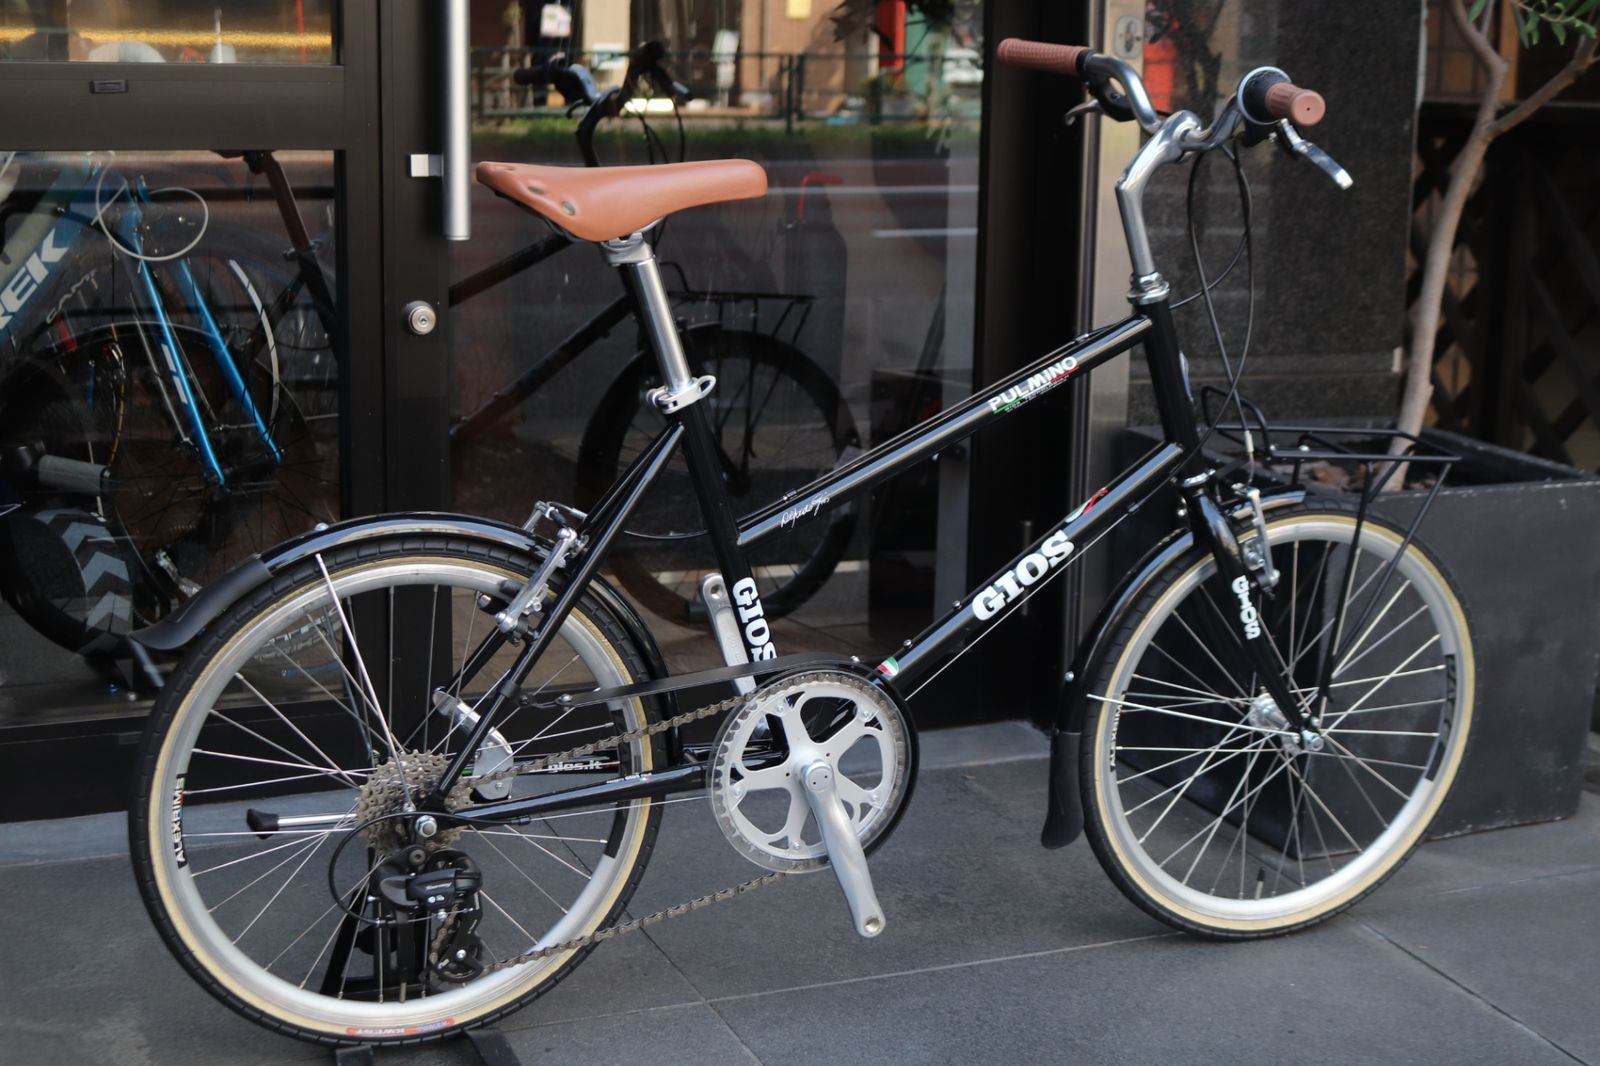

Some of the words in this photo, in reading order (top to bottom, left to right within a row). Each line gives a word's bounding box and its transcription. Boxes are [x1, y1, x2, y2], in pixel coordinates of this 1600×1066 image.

[988, 356, 1078, 411] PULMINO
[972, 529, 1075, 620] GIOS
[1231, 574, 1261, 640] GIOS
[732, 576, 778, 663] GIOS
[172, 777, 186, 862] ALEXRIMS
